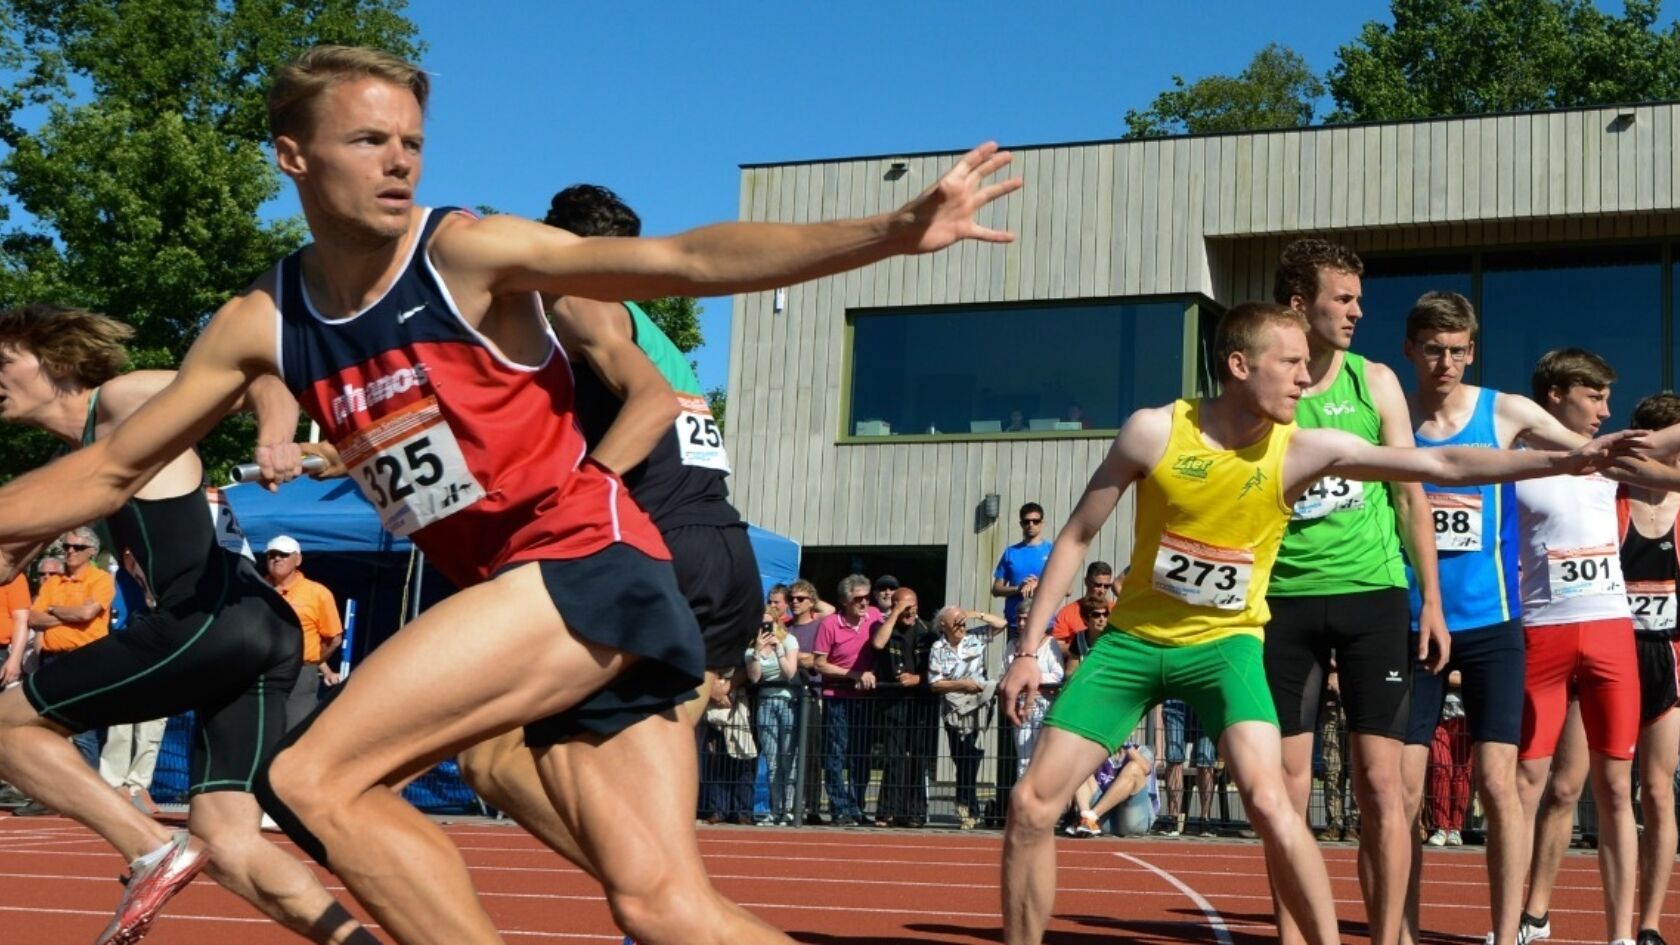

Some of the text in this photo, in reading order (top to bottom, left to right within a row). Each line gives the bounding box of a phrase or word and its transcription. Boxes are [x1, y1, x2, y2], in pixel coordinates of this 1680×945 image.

[363, 435, 444, 510] 325
[1296, 475, 1350, 501] 43
[222, 507, 244, 538] 2
[1165, 554, 1238, 591] 273
[1560, 557, 1610, 583] 301
[1626, 595, 1670, 616] 27
